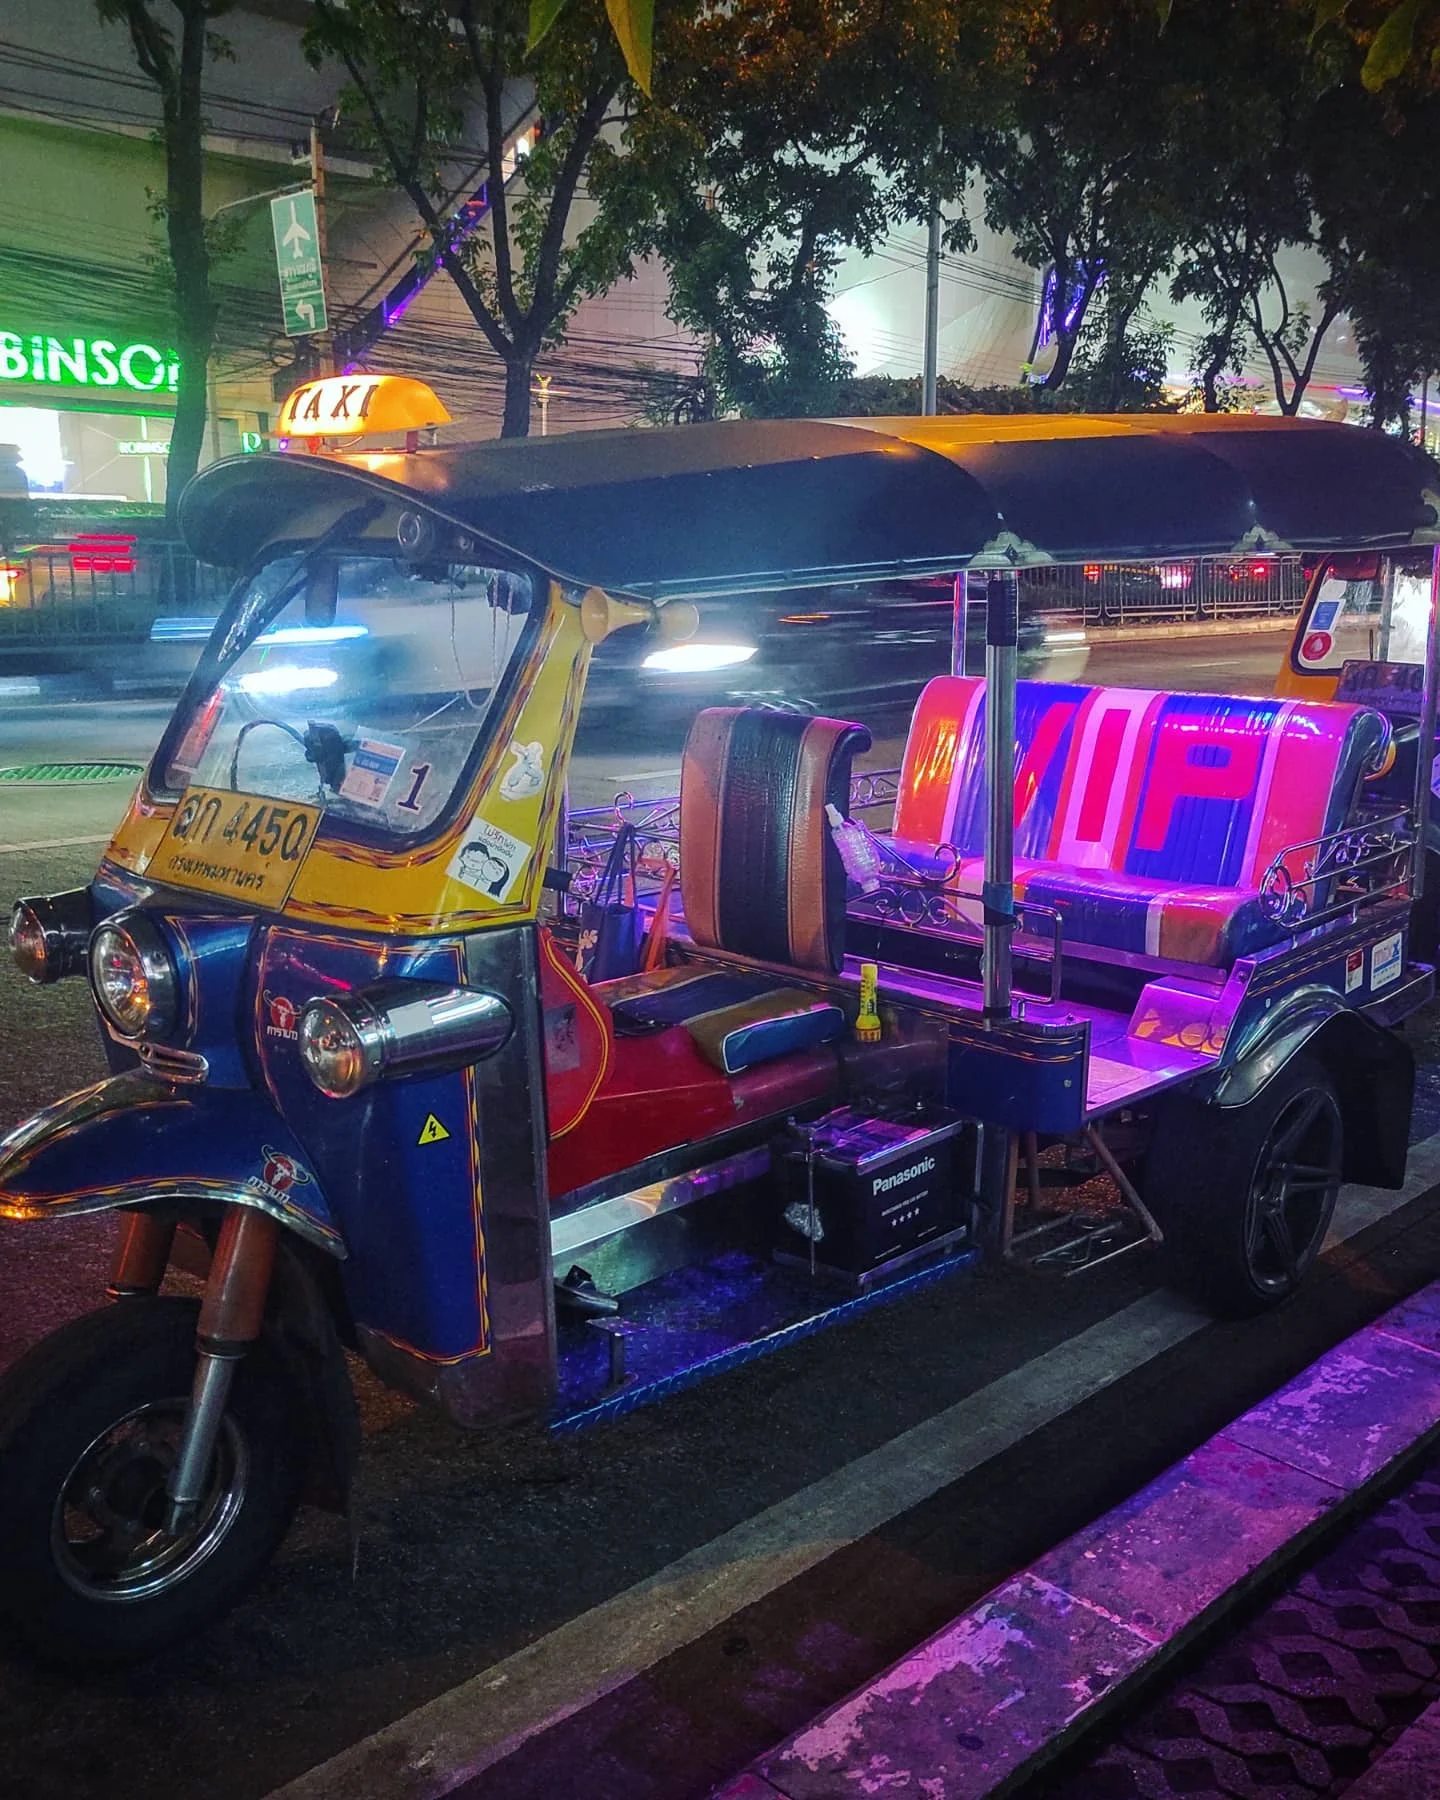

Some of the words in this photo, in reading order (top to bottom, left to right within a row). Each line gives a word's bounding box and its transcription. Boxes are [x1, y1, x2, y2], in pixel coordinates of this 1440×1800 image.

[288, 384, 379, 421] TAXI
[398, 764, 430, 811] 1
[222, 802, 308, 862] 4450
[872, 1156, 936, 1197] Panasonic
